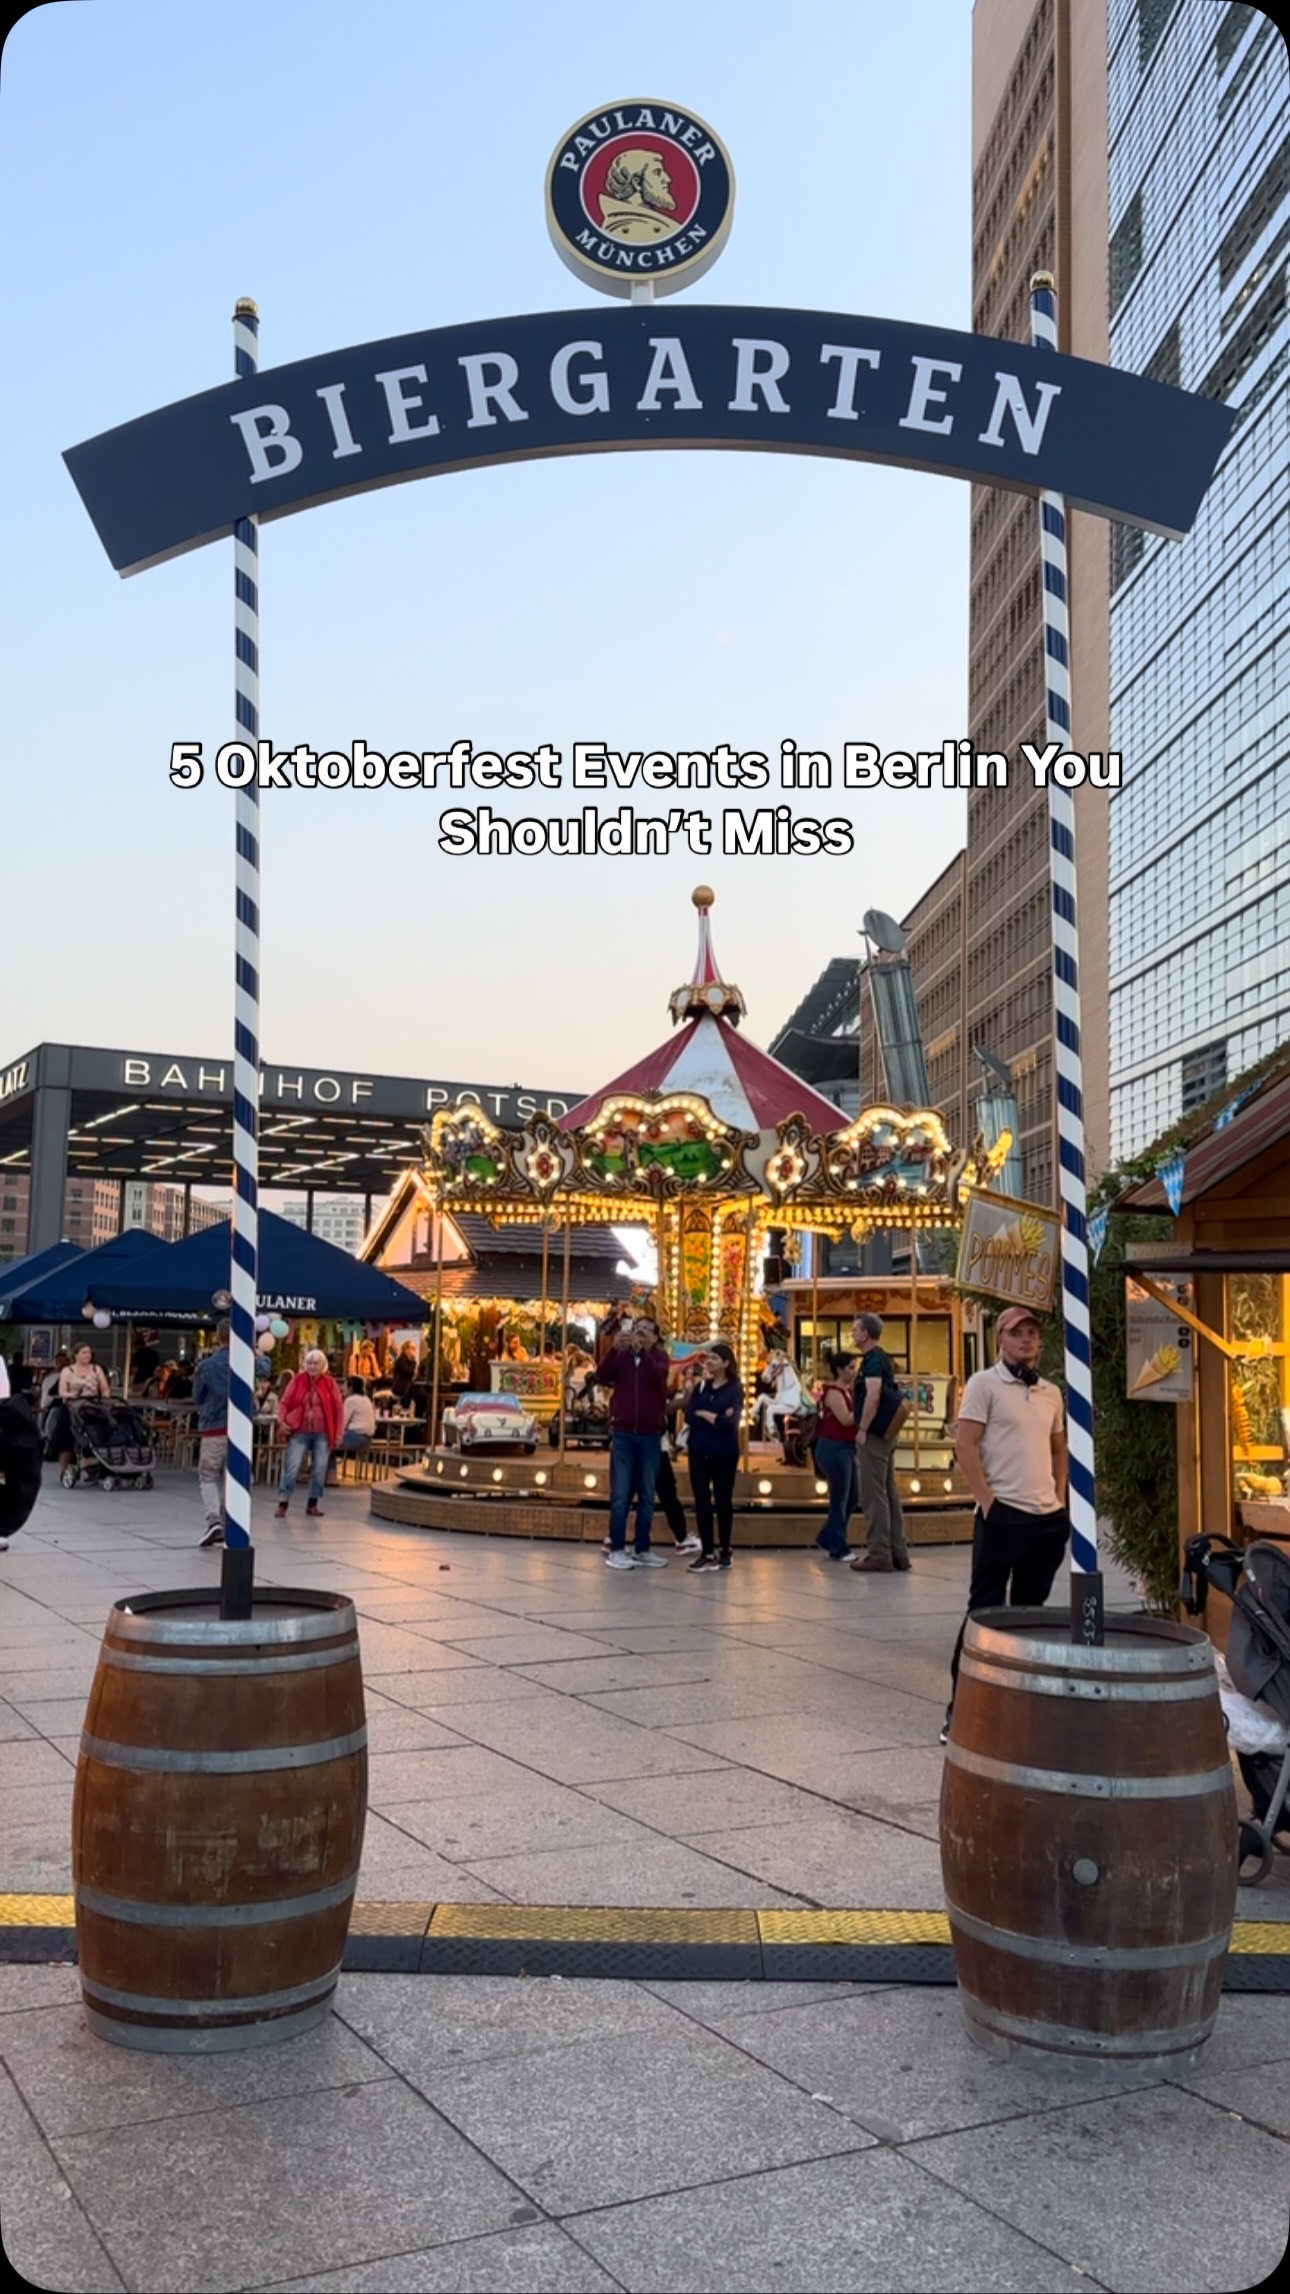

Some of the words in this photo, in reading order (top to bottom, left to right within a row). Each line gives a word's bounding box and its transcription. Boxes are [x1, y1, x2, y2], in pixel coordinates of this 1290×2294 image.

[560, 108, 716, 173] PAULANER
[575, 223, 708, 268] MÜNCHEN
[230, 337, 1063, 485] BIERGARTEN
[124, 1059, 373, 1105] BAHHOF
[965, 1231, 1050, 1300] POMMES
[255, 1295, 316, 1310] ULANER
